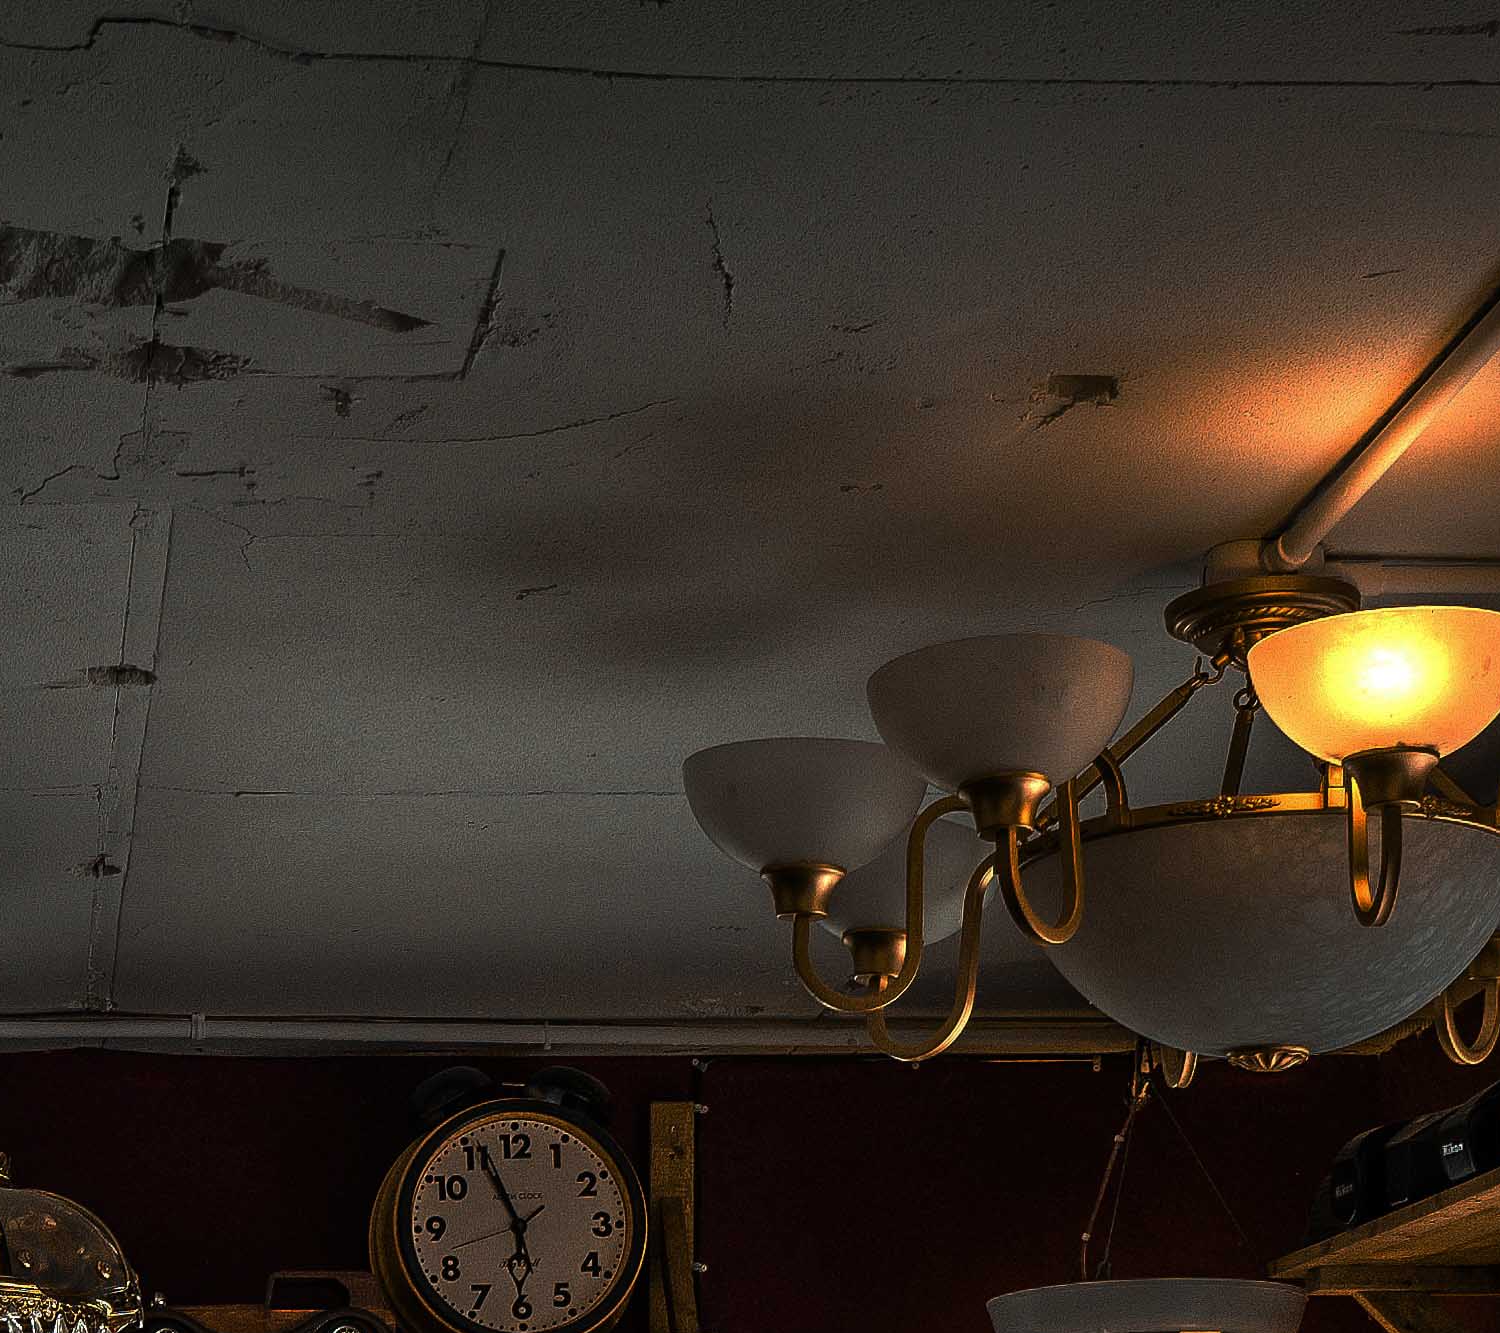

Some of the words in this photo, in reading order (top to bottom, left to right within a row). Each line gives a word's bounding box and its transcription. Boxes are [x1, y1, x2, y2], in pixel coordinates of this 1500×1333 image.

[463, 1145, 489, 1171] 11
[499, 1133, 532, 1160] 12
[549, 1143, 562, 1169] 1
[434, 1174, 468, 1201] 10
[576, 1171, 598, 1198] 2
[425, 1215, 447, 1242] 9
[592, 1211, 613, 1238] 3
[441, 1255, 461, 1282] 8
[580, 1251, 602, 1278] 4
[471, 1284, 492, 1310] 7
[511, 1294, 533, 1320] 6
[553, 1282, 572, 1308] 5
